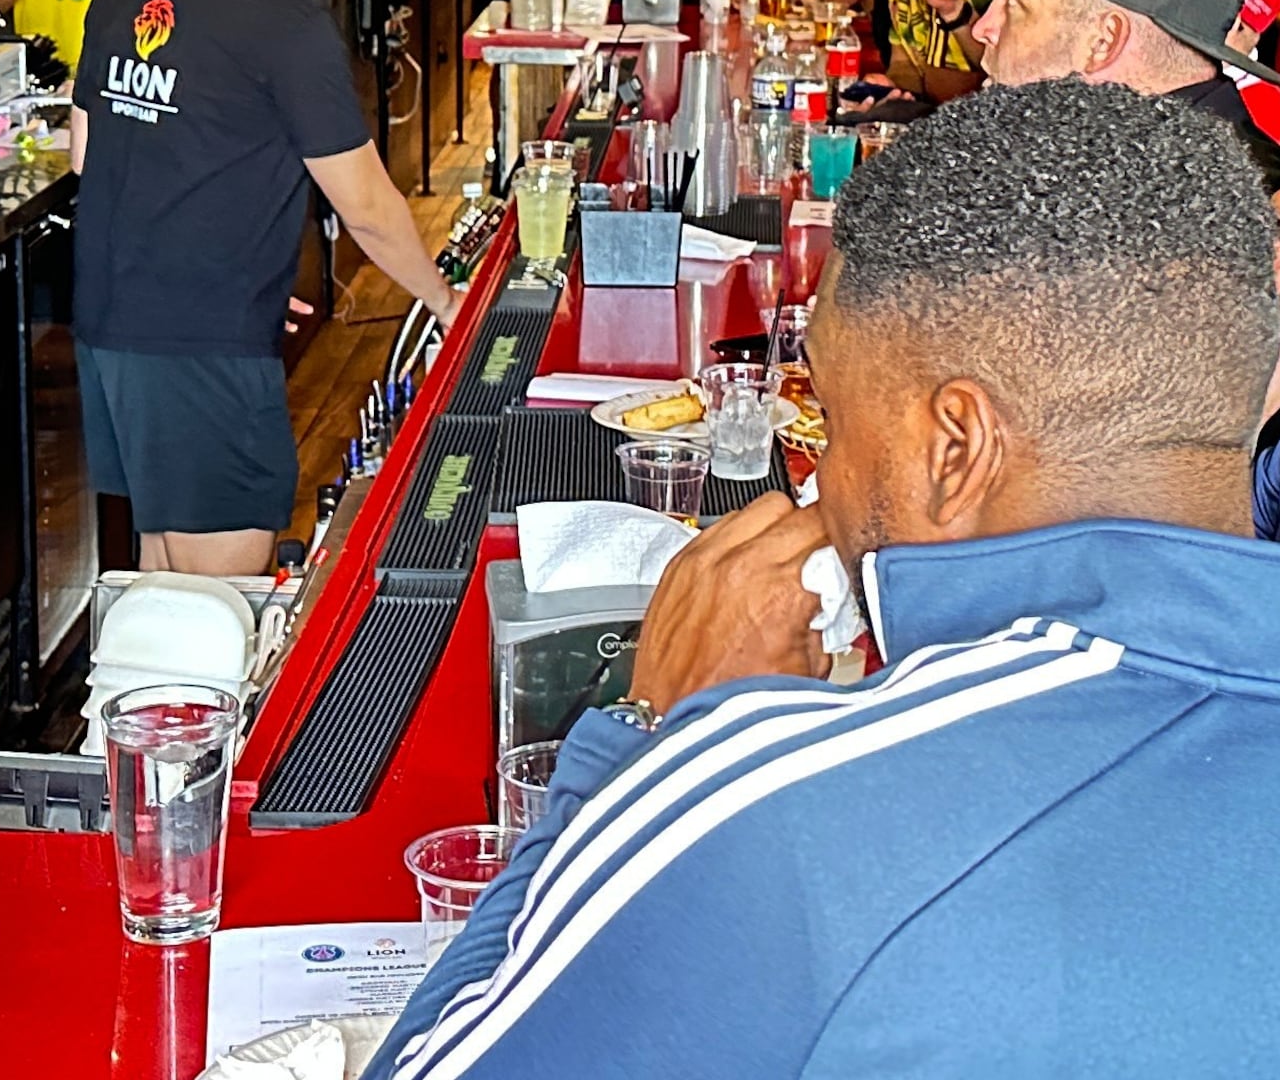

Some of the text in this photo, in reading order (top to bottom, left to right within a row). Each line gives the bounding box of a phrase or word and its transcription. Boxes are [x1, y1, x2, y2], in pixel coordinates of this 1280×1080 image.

[107, 56, 178, 105] LION
[366, 948, 407, 957] LION
[382, 963, 428, 972] LEAGUE
